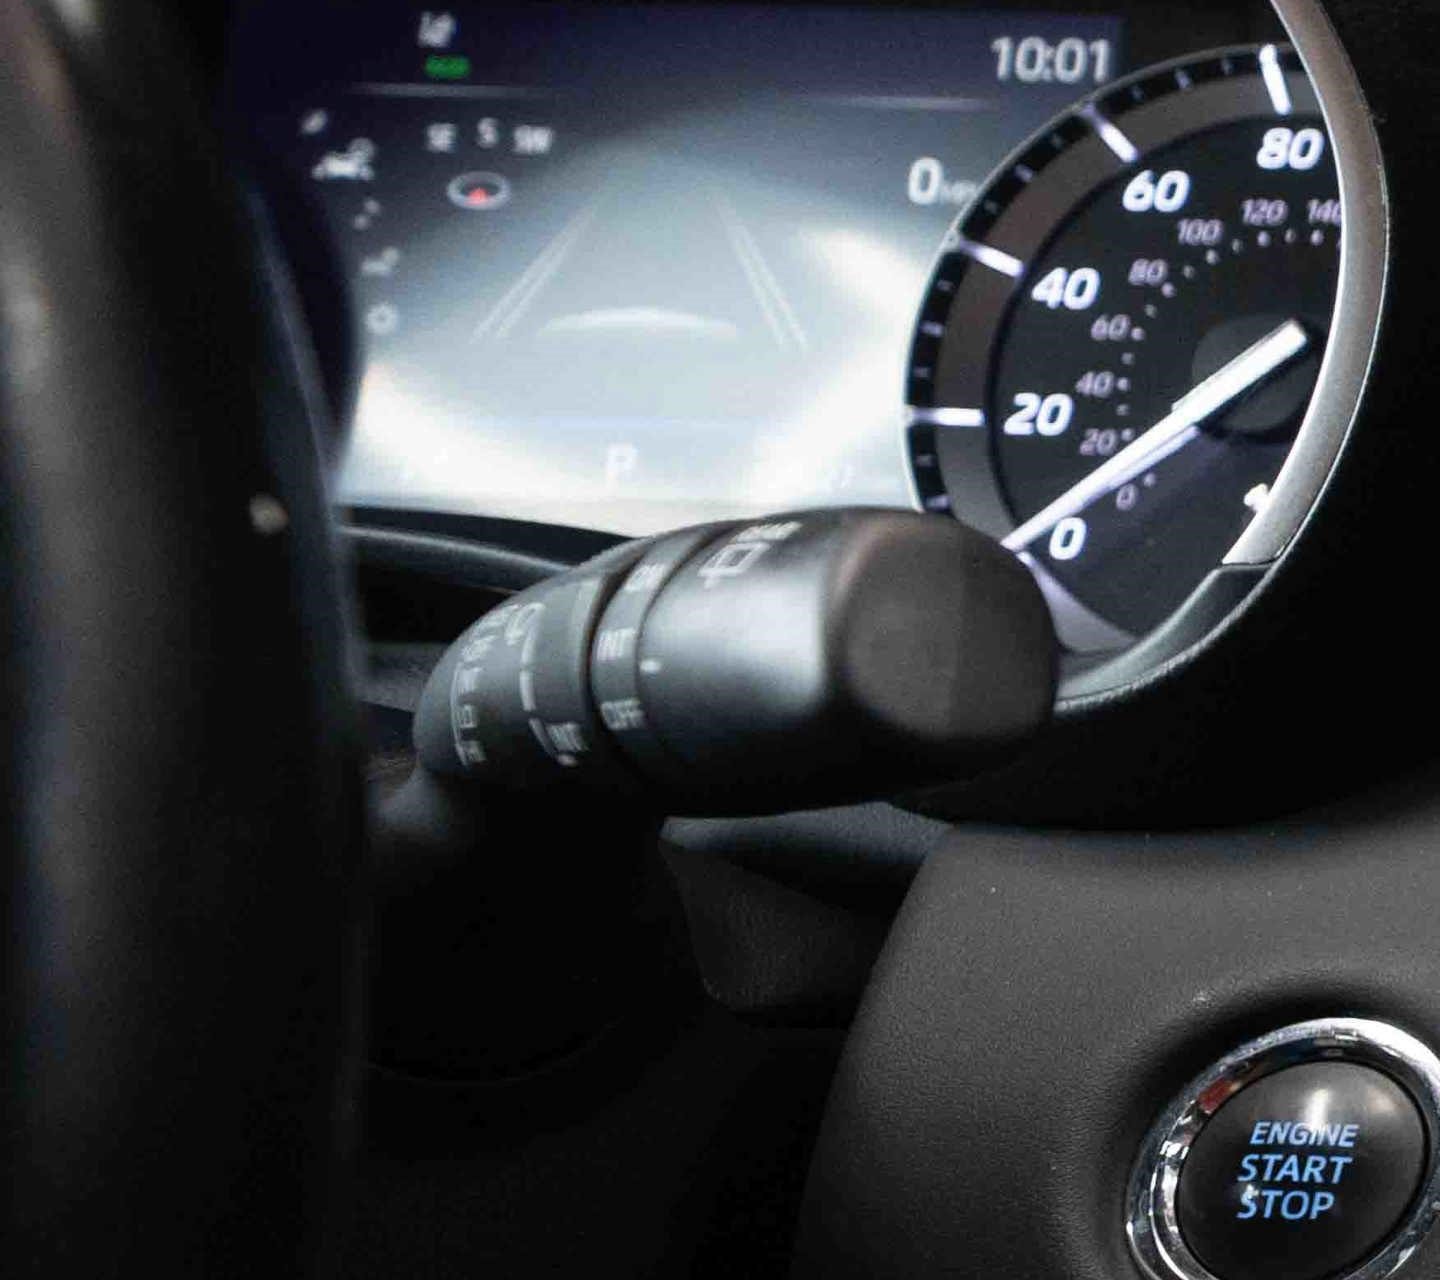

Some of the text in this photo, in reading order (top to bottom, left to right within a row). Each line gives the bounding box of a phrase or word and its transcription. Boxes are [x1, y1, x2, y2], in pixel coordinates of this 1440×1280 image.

[992, 36, 1110, 84] 10:01
[1256, 127, 1326, 170] 80
[908, 157, 943, 205] 0
[1122, 169, 1191, 213] 60
[1242, 199, 1288, 225] 120
[1178, 219, 1223, 244] 100
[1031, 267, 1100, 311] 40
[1128, 260, 1168, 286] 80
[1091, 315, 1131, 340] 60
[1077, 372, 1114, 396] 40
[1004, 393, 1074, 437] 20
[1080, 428, 1118, 454] 20
[1049, 518, 1087, 560] 0
[1248, 1121, 1360, 1148] ENGINE
[1237, 1153, 1352, 1185] START
[1237, 1188, 1334, 1220] STOP
